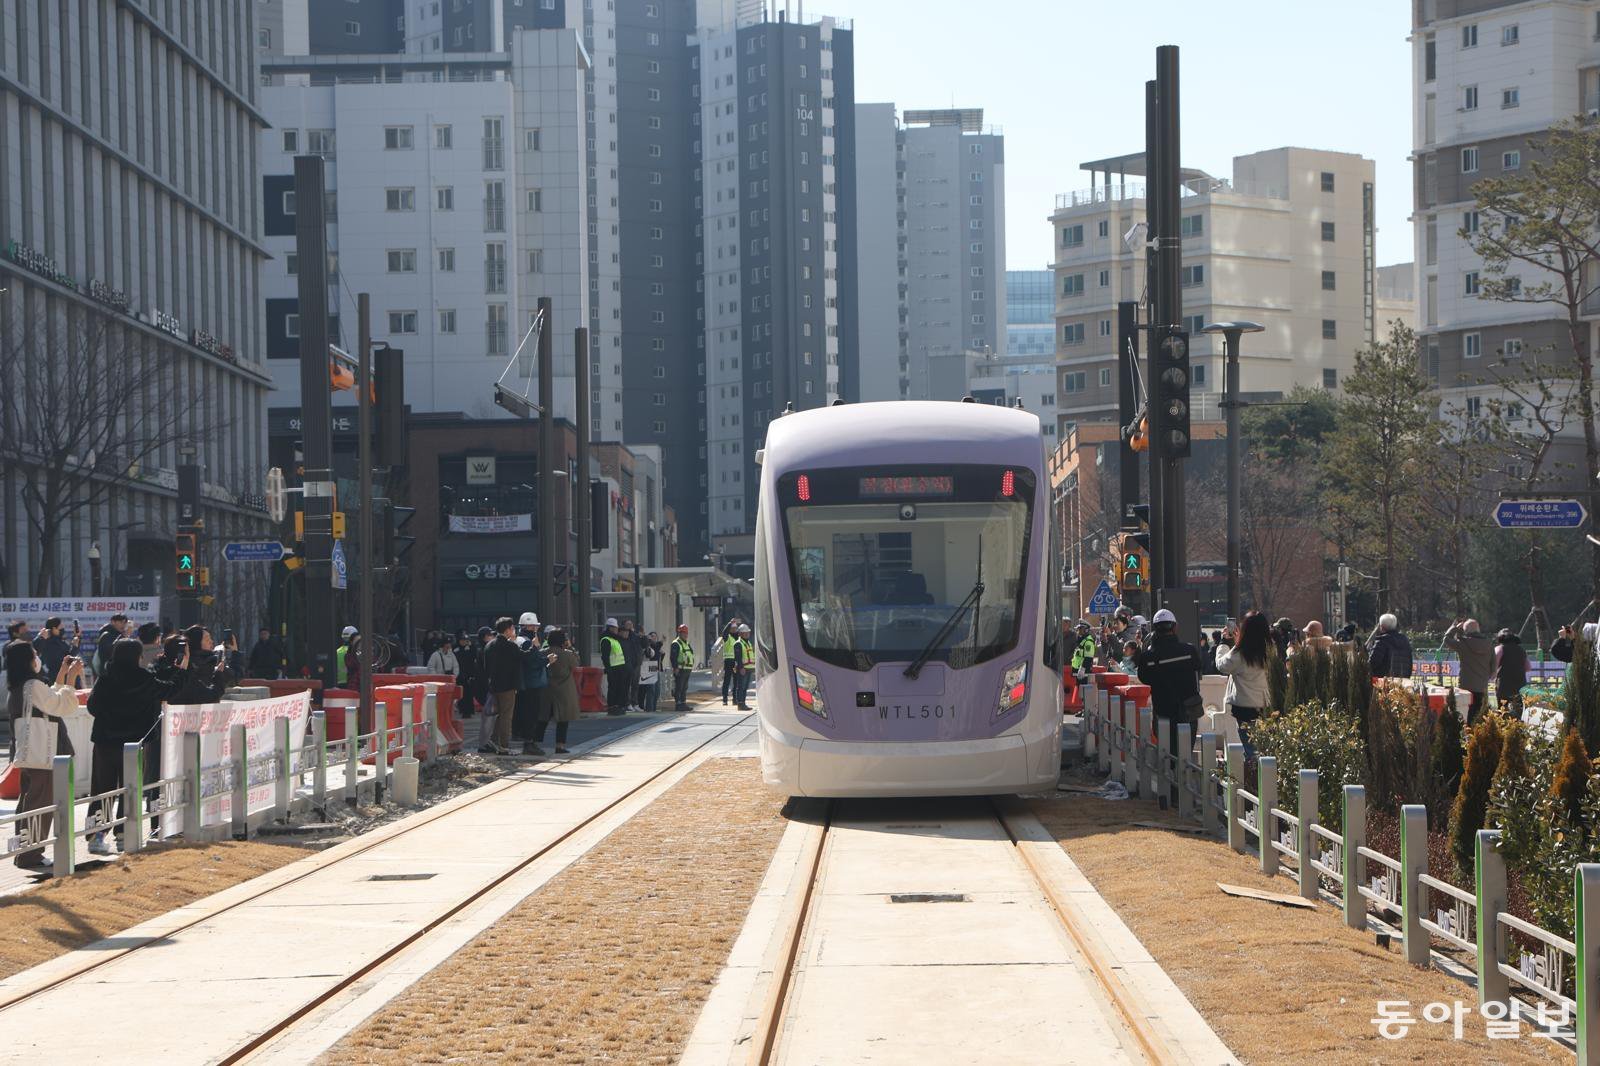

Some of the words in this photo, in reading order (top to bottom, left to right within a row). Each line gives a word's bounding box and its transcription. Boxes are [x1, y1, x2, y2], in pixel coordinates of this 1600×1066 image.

[797, 108, 813, 120] 104
[0, 602, 16, 612] 램)
[20, 602, 39, 613] 본선
[42, 602, 71, 612] 시운전
[74, 602, 84, 612] 및
[86, 602, 126, 612] 레일연마
[129, 601, 149, 612] 시행
[879, 705, 955, 719] WTL501
